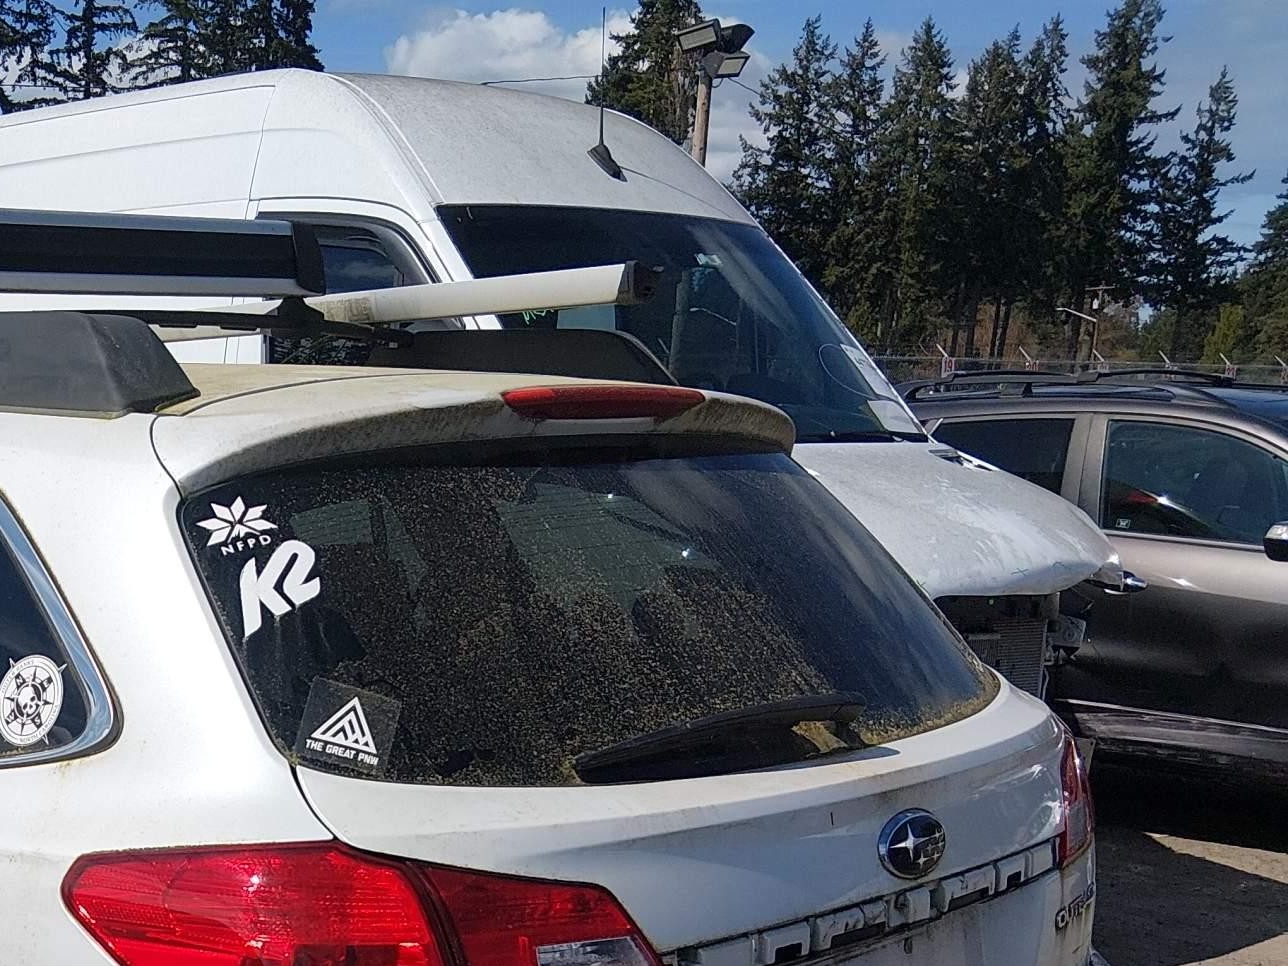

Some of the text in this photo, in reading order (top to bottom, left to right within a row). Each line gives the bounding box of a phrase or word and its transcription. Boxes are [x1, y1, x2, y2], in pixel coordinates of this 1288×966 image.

[220, 534, 272, 556] NFPD
[239, 539, 321, 637] K2
[305, 739, 380, 766] THE GREAT PNW
